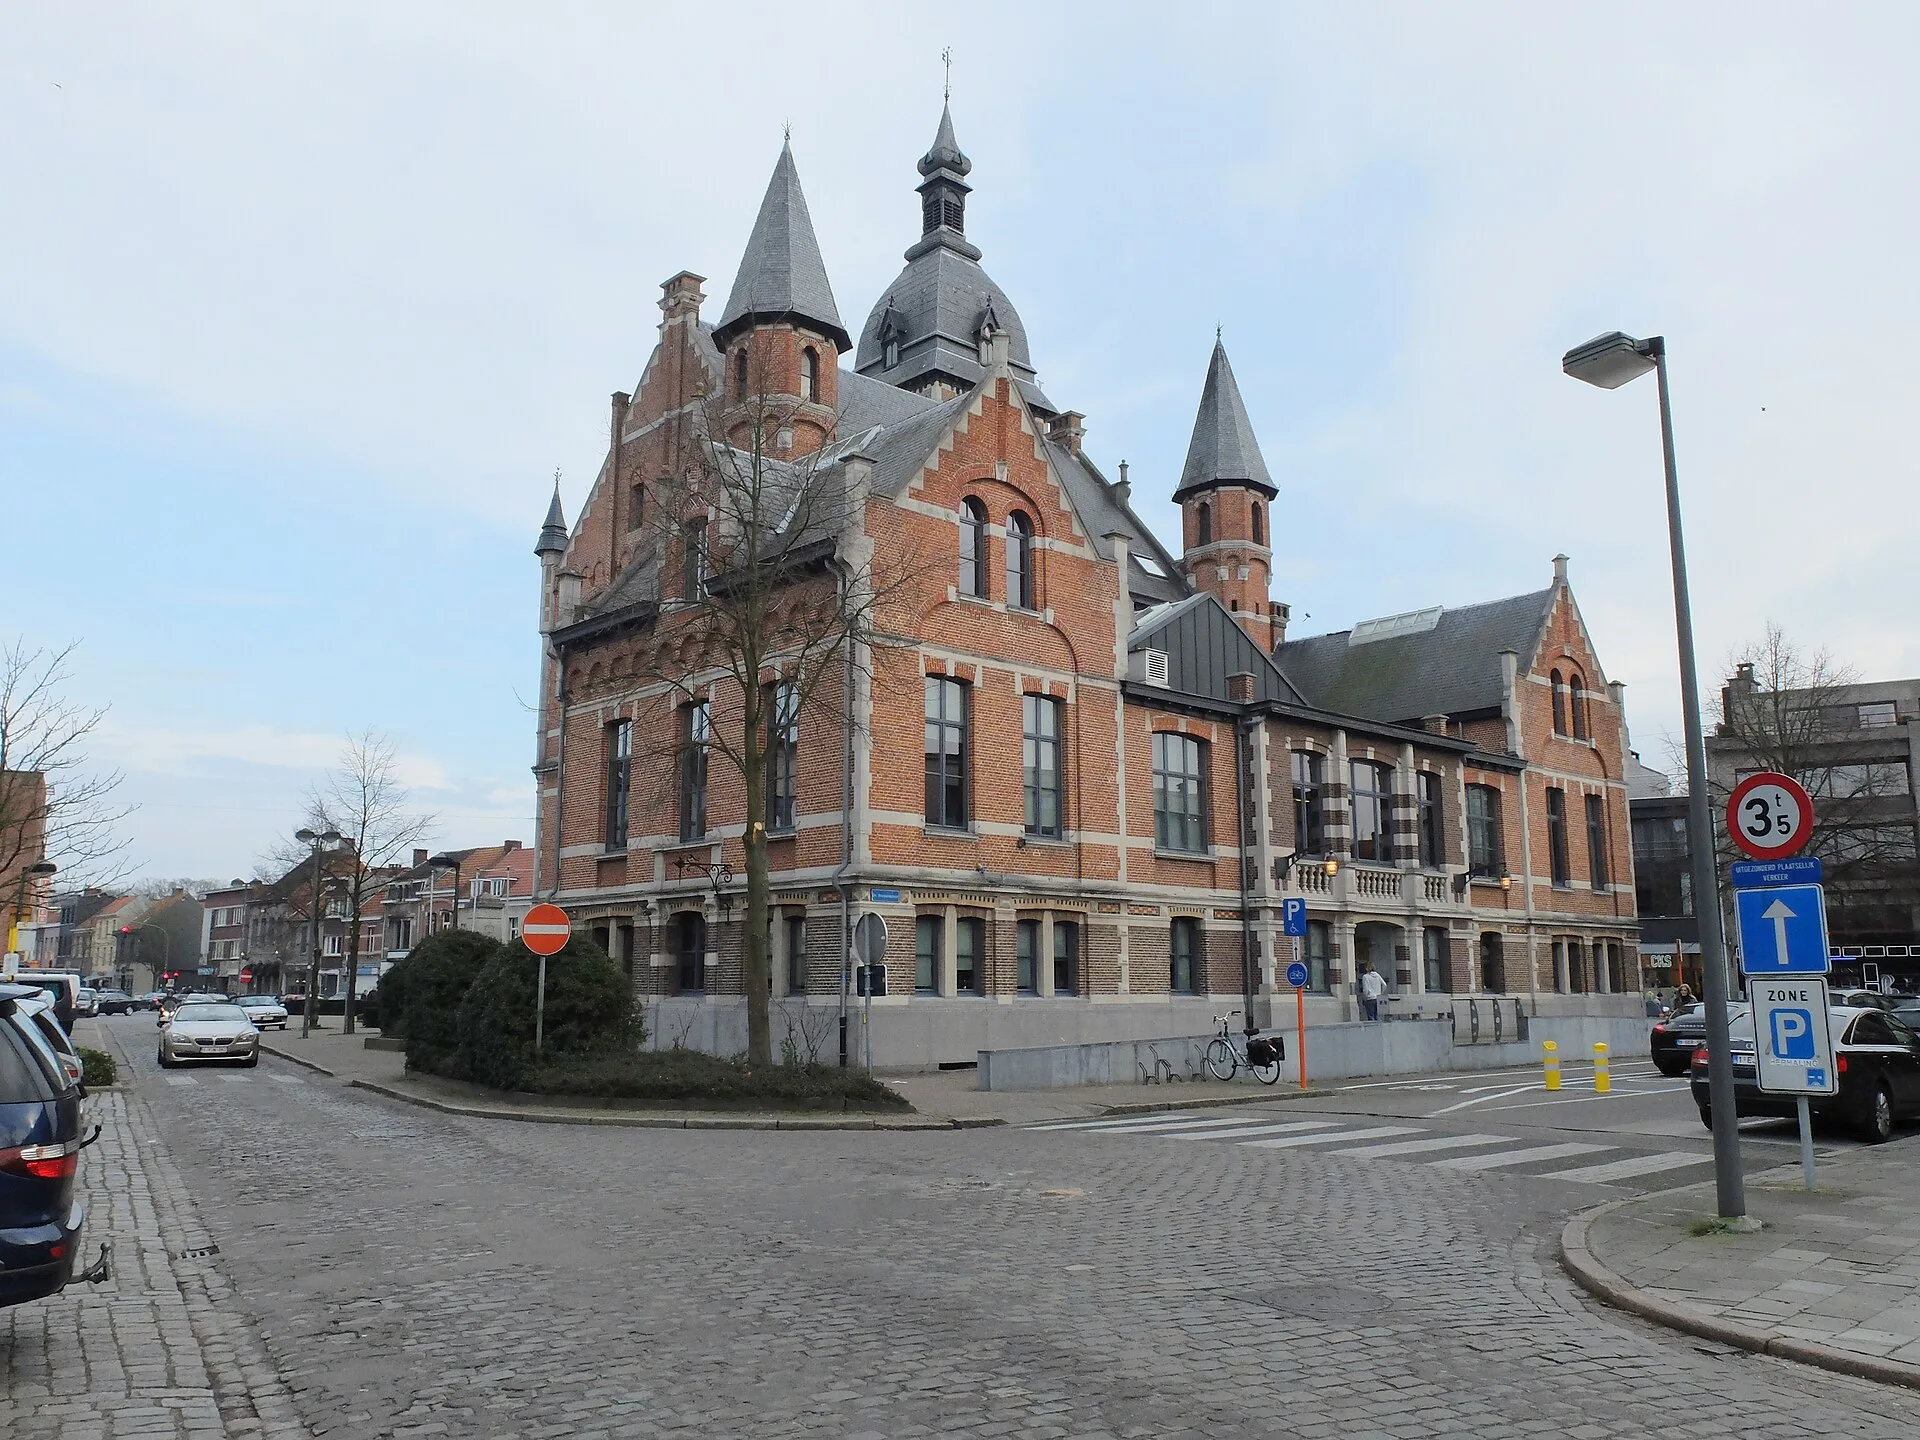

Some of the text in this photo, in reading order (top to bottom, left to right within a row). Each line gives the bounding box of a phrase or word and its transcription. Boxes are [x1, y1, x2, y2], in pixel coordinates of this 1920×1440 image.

[1745, 798, 1772, 837] 3
[1777, 815, 1791, 835] 5
[1735, 861, 1815, 873] UITGEZONDERD PLAATSELIJK
[1762, 873, 1789, 882] VERKEER
[1287, 900, 1300, 921] P
[1767, 990, 1808, 1002] ZONE
[1775, 1012, 1807, 1055] P
